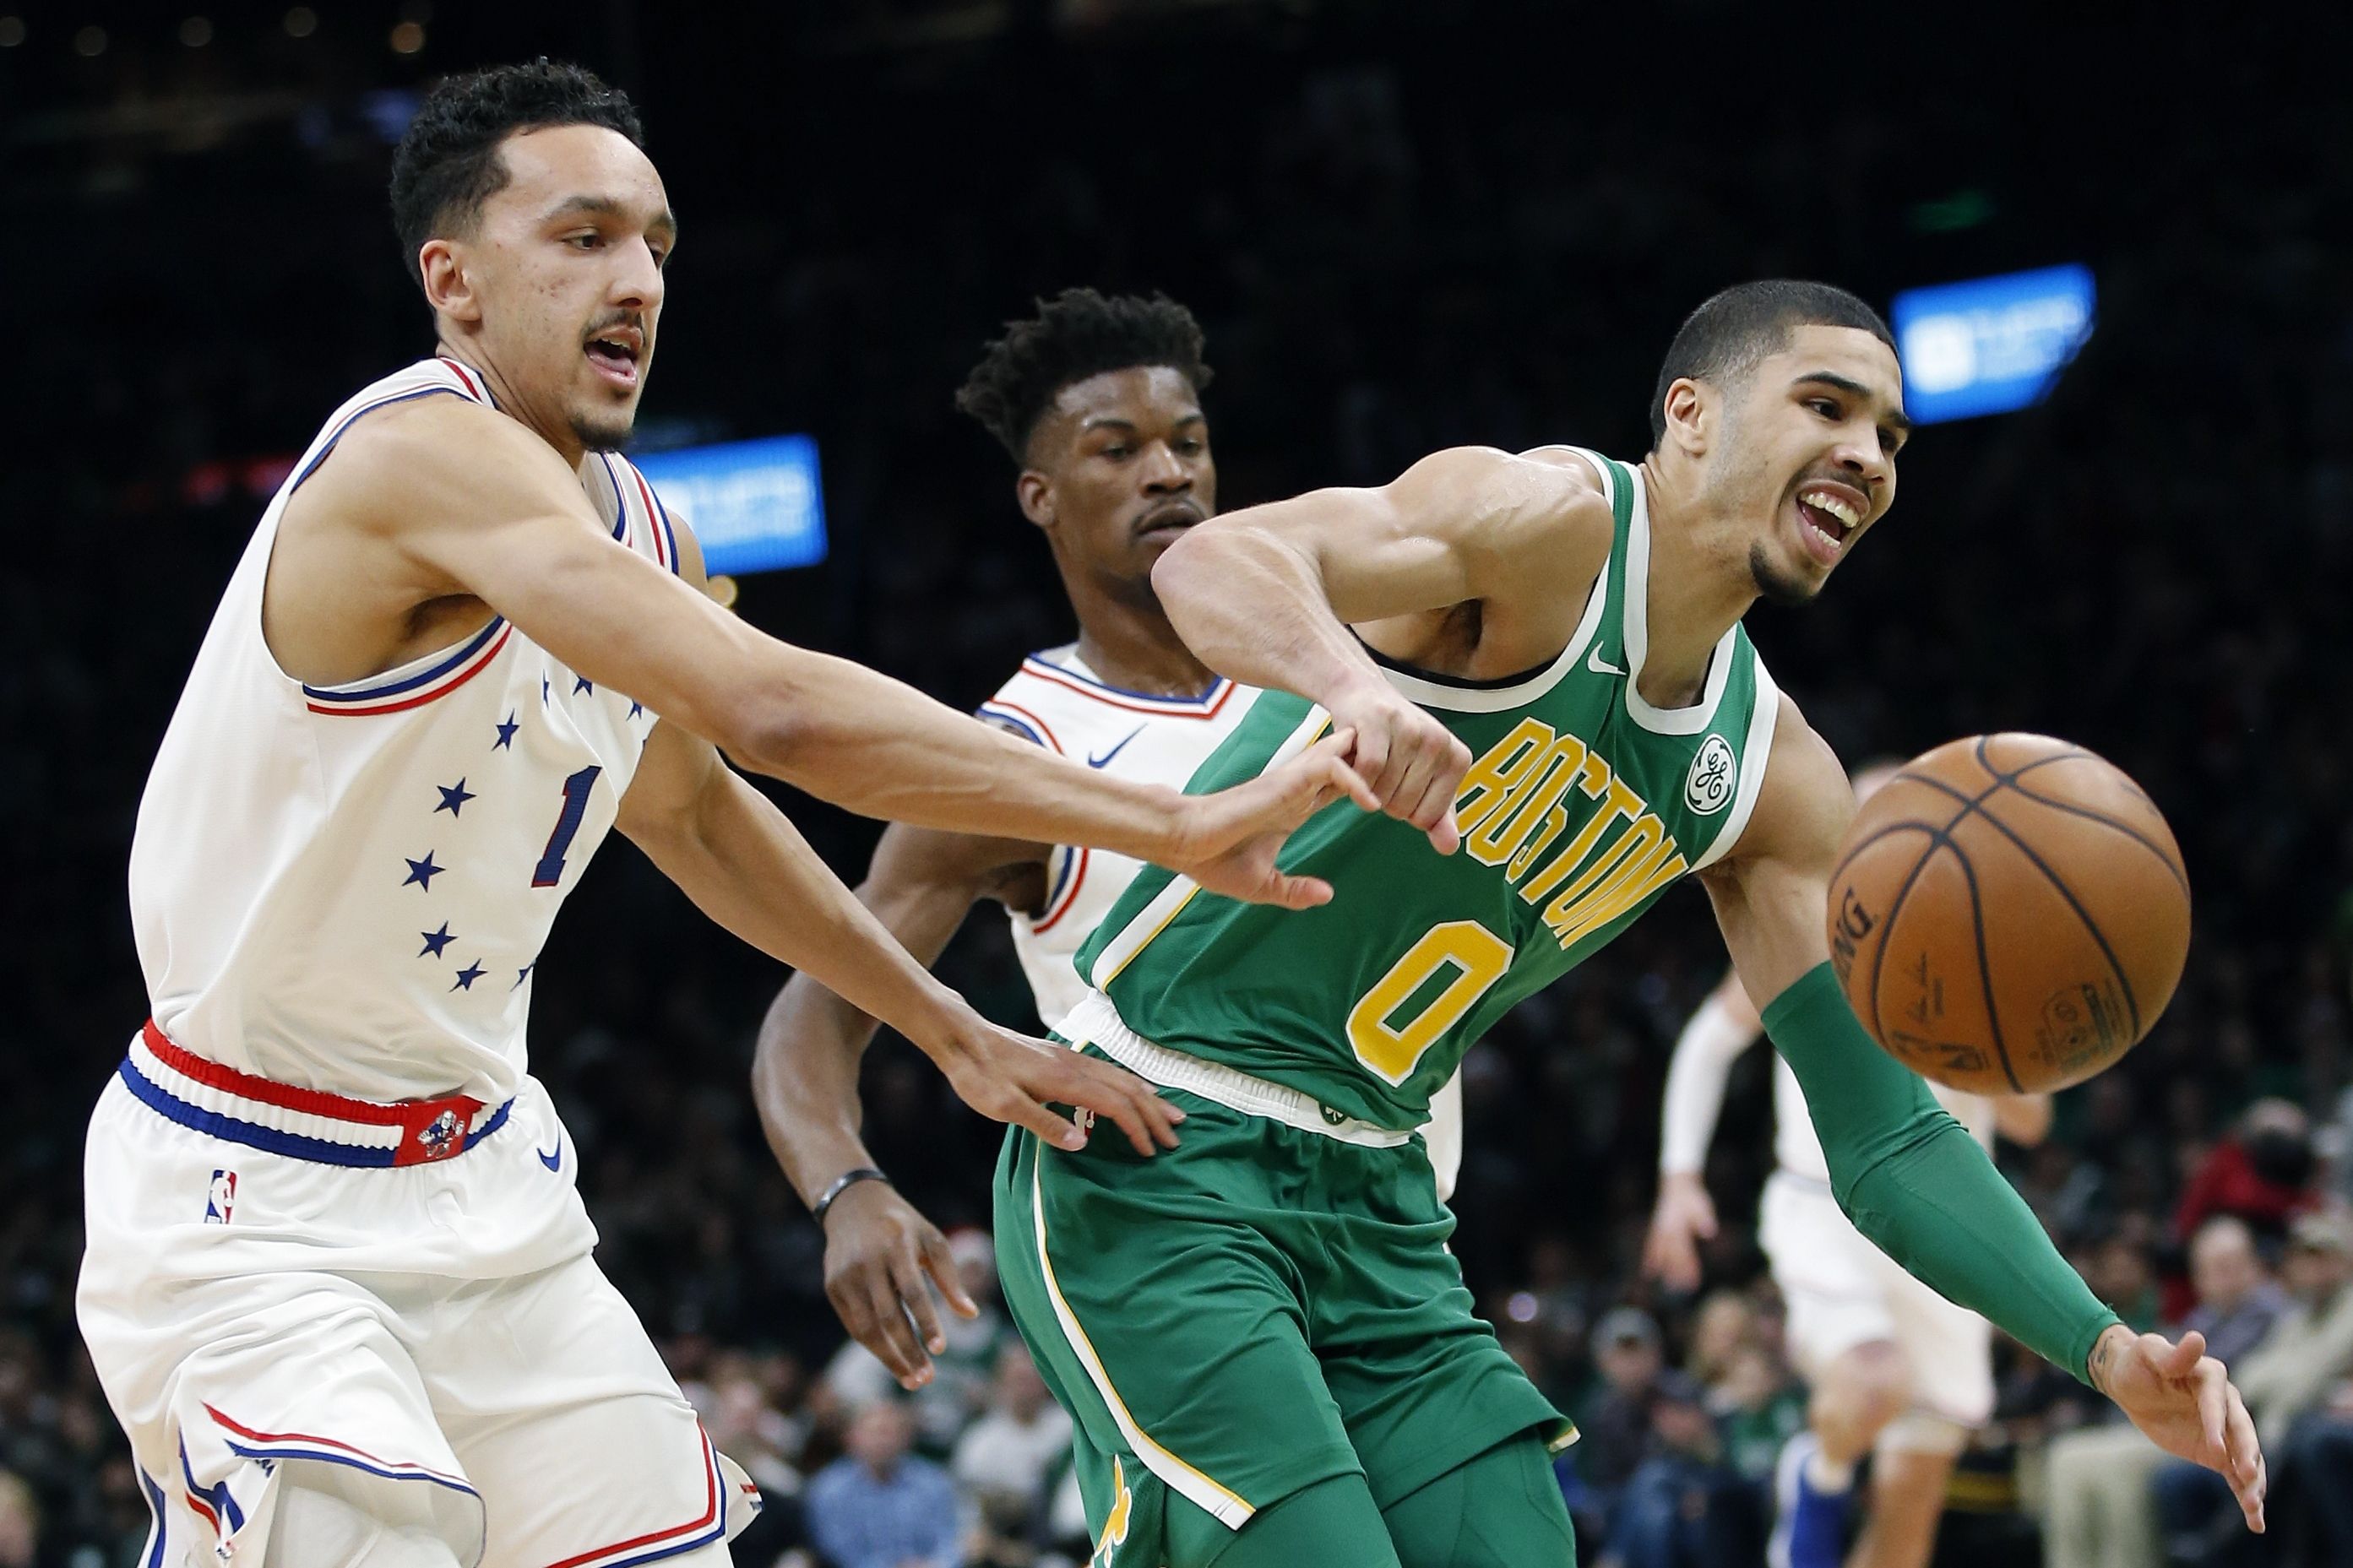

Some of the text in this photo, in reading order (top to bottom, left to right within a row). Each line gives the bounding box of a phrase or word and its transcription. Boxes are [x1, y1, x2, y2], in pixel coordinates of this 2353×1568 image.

[531, 765, 602, 888] 1
[1454, 717, 1689, 951] BOSTON
[1345, 920, 1515, 1088] 0
